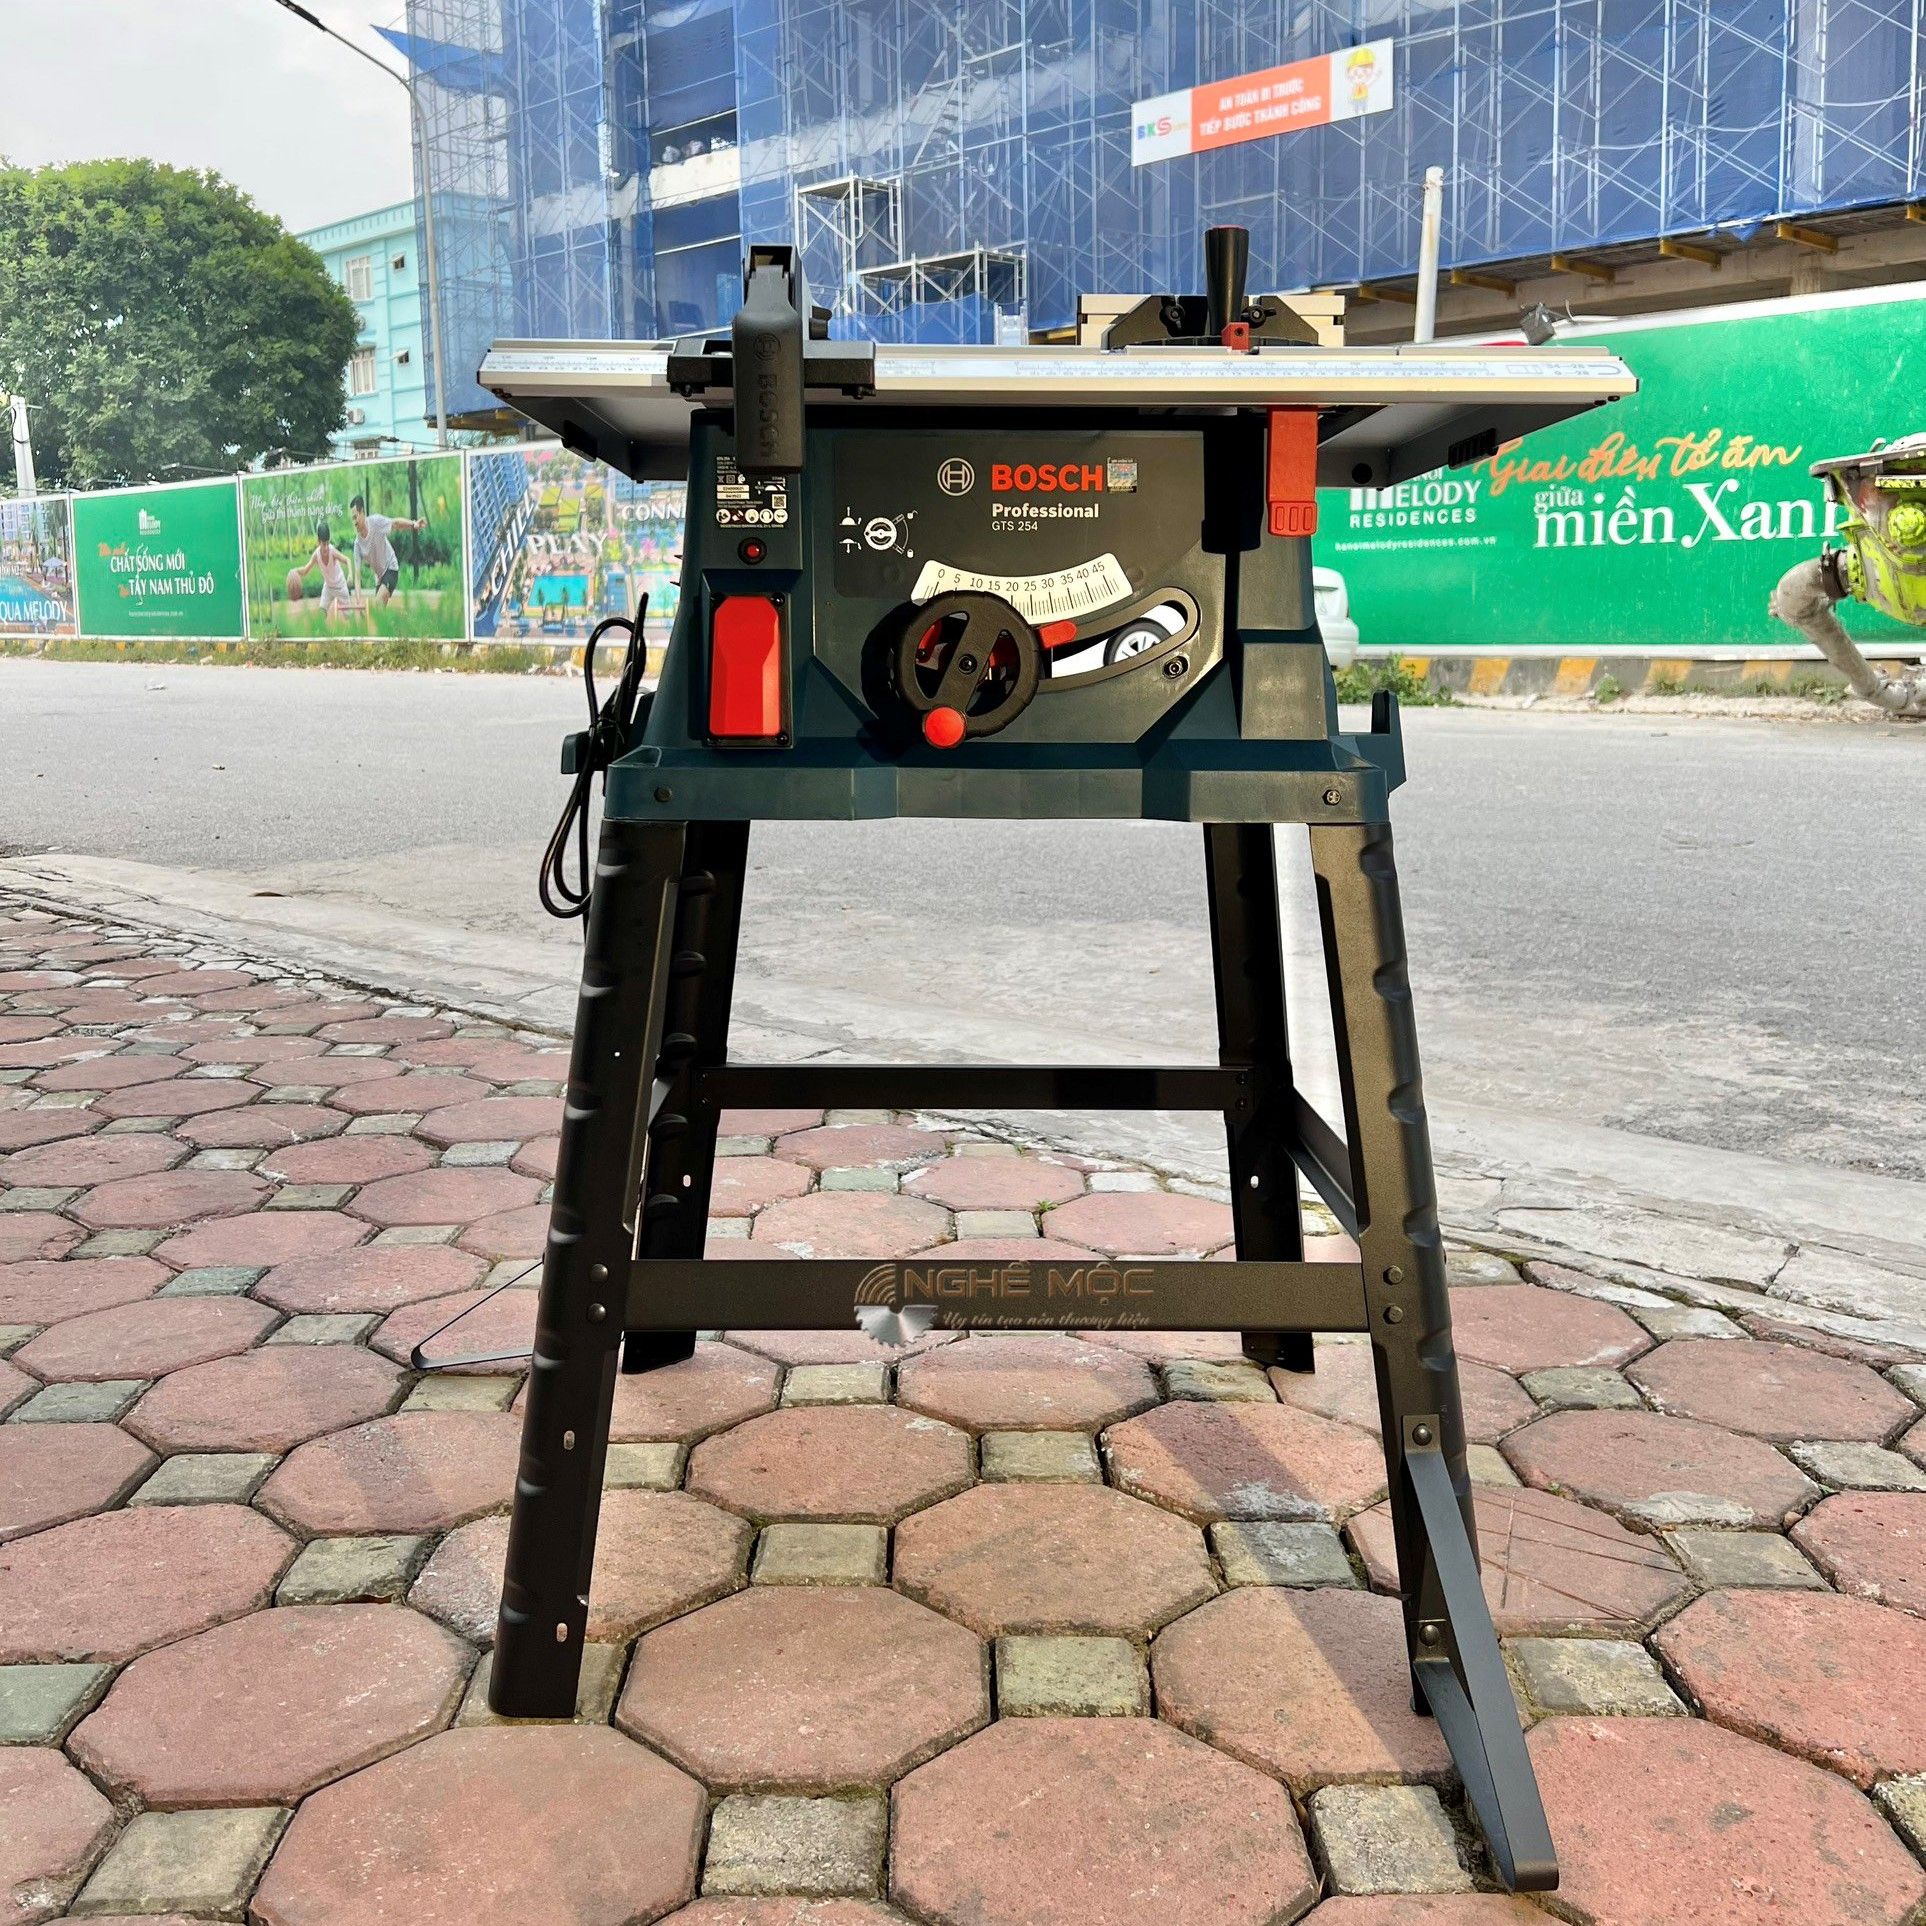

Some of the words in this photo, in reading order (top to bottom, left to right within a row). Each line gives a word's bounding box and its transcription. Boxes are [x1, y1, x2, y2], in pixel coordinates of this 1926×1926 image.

[991, 463, 1104, 492] BOSCH
[991, 502, 1099, 518] Professional
[1534, 483, 1585, 514] giữa
[991, 521, 1014, 531] GTS
[1018, 520, 1038, 531] 254
[1350, 507, 1477, 529] RESIDENCES
[1533, 485, 1676, 548] miền
[526, 532, 608, 555] PLAY
[110, 547, 135, 573] CHẤT
[166, 548, 185, 571] MỚI
[150, 578, 173, 595] NAM
[174, 570, 196, 595] THỦ
[199, 570, 214, 595] ĐÔ
[937, 568, 946, 579] 0
[953, 574, 961, 584] 5
[969, 577, 983, 589] 10
[988, 581, 1001, 591] 15
[1005, 581, 1019, 592] 20
[1024, 581, 1037, 592] 25
[1041, 578, 1055, 588] 30
[1060, 575, 1074, 585] 35
[1076, 568, 1090, 580] 40
[1092, 561, 1105, 573] 45
[24, 600, 68, 622] MELODY
